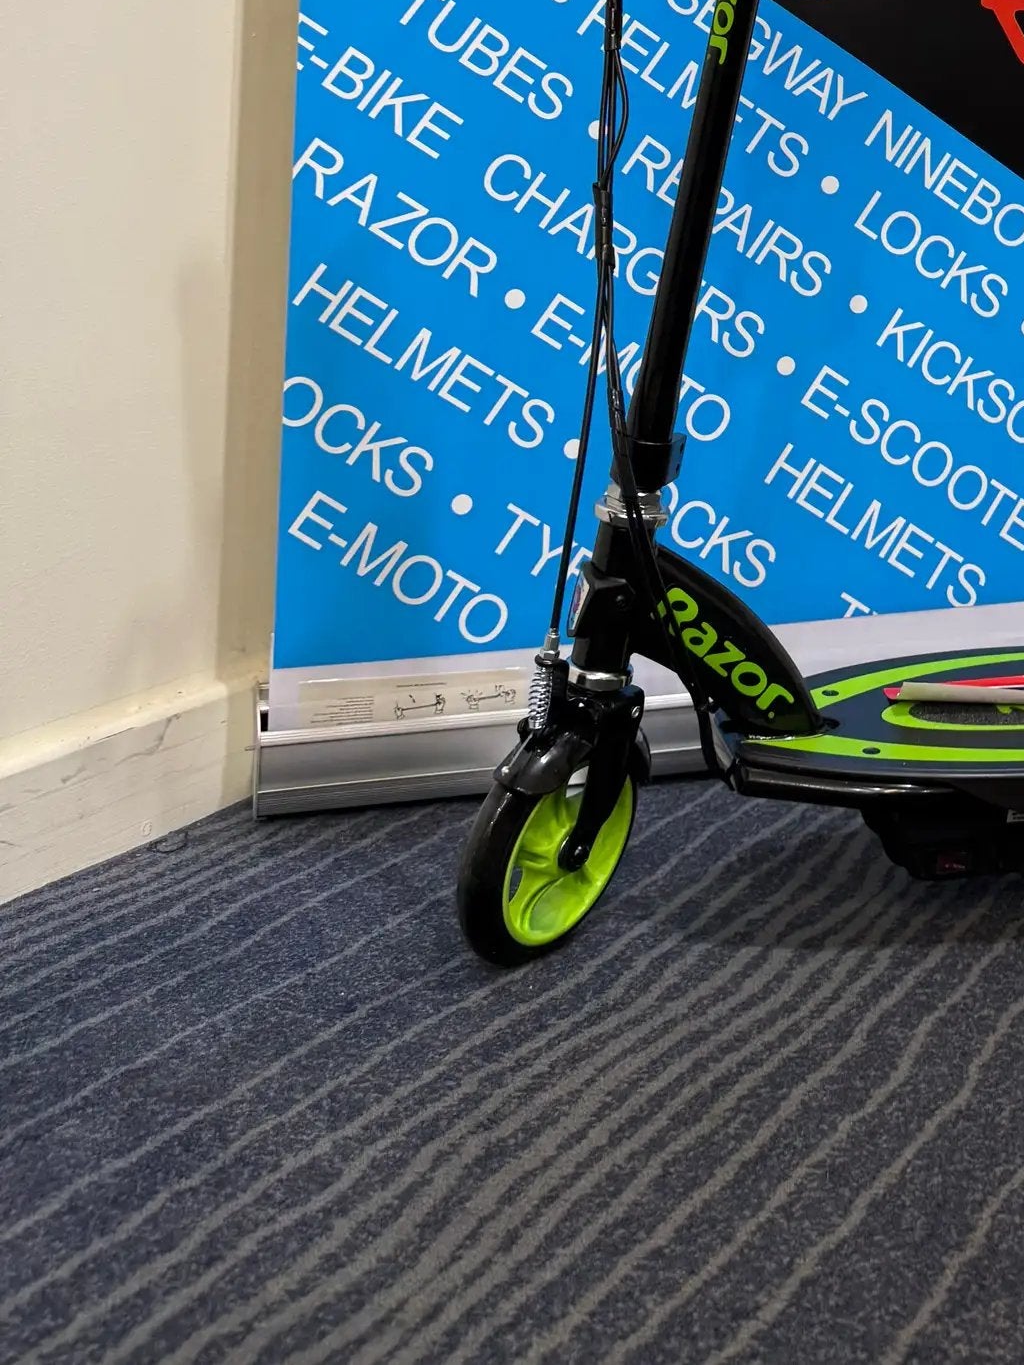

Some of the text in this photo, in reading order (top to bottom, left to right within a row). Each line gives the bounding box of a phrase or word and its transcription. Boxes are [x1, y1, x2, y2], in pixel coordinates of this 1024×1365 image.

[296, 11, 465, 160] E-BIKE
[483, 153, 765, 359] CHARGRS
[854, 190, 1009, 318] LOCKS
[291, 263, 556, 449] HELMETS
[291, 137, 498, 298] RAZOR
[764, 442, 986, 608] HELMETS
[287, 490, 509, 645] E-MOTO
[656, 587, 795, 711] Razor
